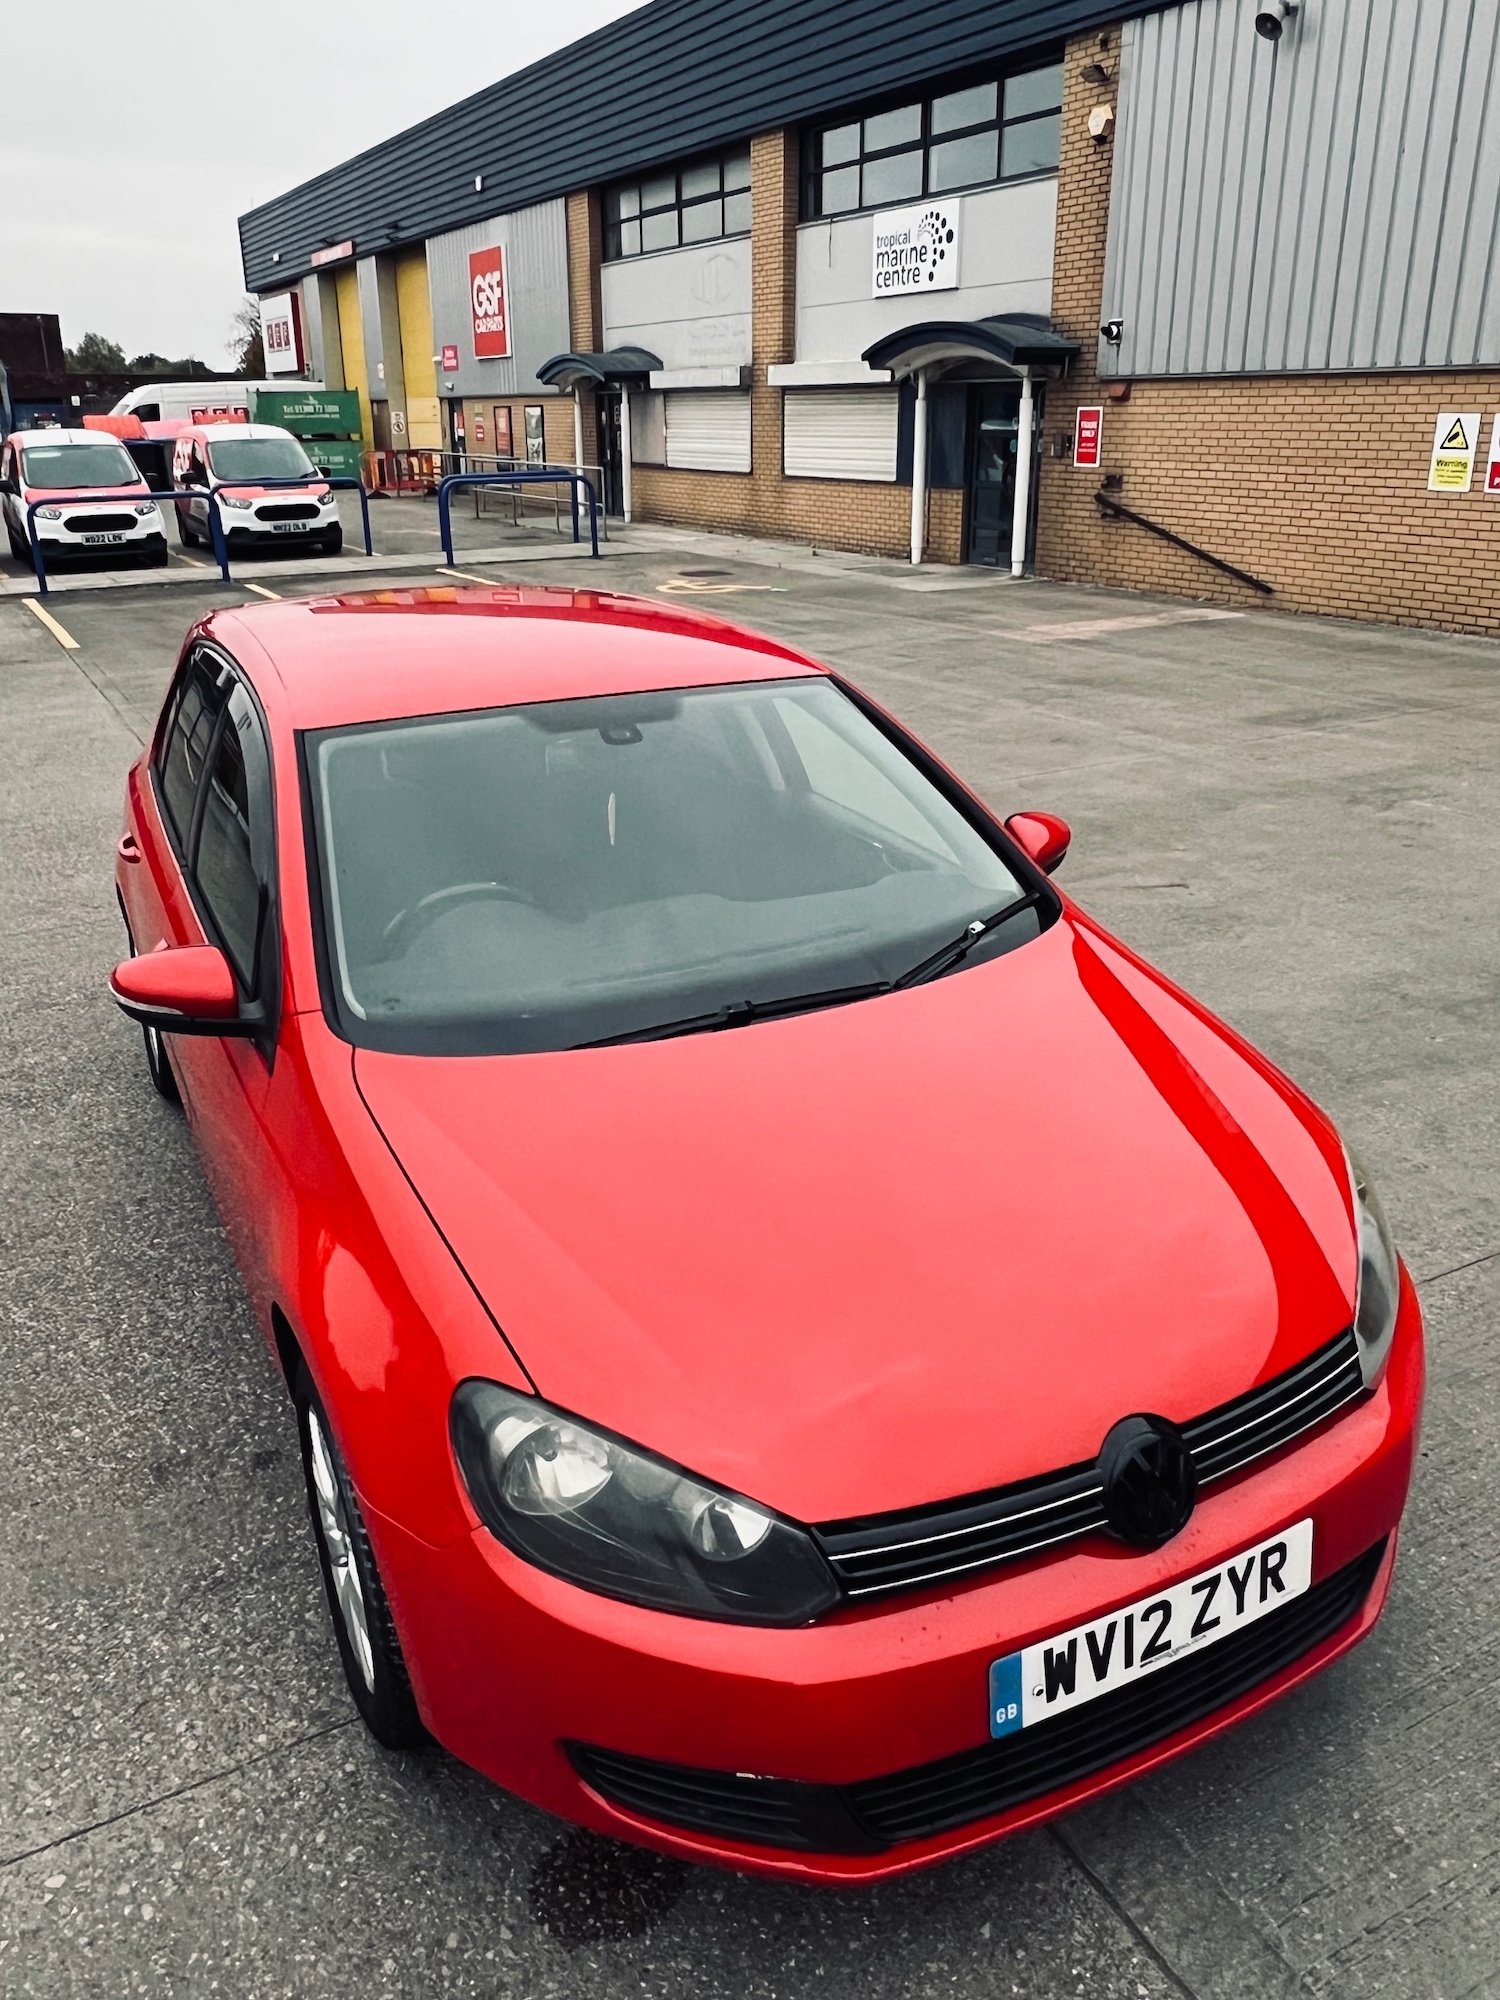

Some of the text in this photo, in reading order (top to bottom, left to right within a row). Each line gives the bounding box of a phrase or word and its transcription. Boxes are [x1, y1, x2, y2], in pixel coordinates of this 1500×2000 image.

[877, 229, 910, 250] tropical
[877, 245, 927, 269] marine
[876, 266, 920, 288] centre
[473, 270, 502, 317] GSF
[1436, 459, 1468, 469] Warning
[1043, 1541, 1287, 1703] WV12 ZYR
[996, 1703, 1017, 1724] GB
